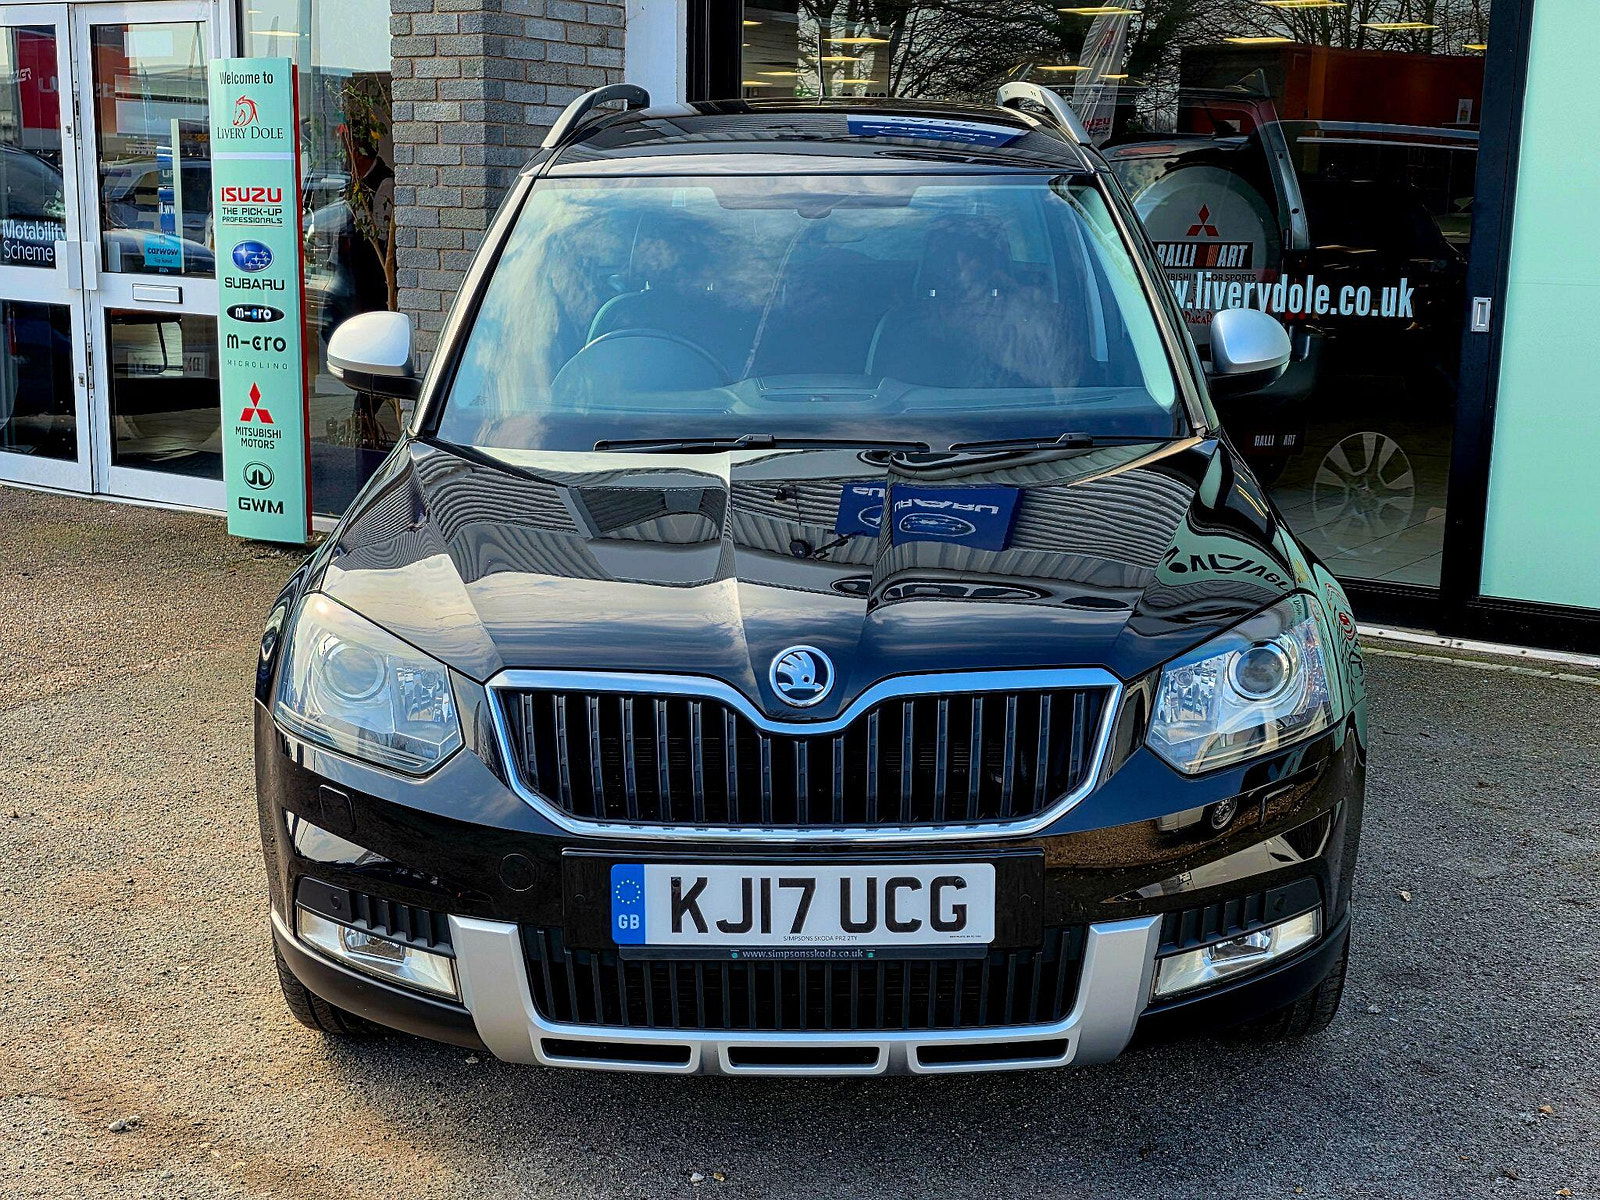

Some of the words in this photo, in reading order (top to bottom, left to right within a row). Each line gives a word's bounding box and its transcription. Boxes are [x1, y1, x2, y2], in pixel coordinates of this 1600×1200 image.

[219, 71, 260, 85] Welcome
[262, 71, 274, 84] to
[221, 187, 282, 203] ISUZU
[222, 207, 238, 215] THE
[241, 207, 283, 216] PICK-UP
[222, 216, 283, 224] PROFESSIONALS
[2, 219, 67, 241] Motability
[3, 240, 54, 262] Scheme
[224, 276, 285, 291] SUBARU
[1225, 273, 1257, 281] SPORTS
[227, 359, 288, 370] MICROLINO
[235, 426, 282, 439] MITSUBISHI
[241, 438, 275, 450] MOTORS
[238, 496, 284, 514] GWM
[670, 876, 817, 934] KJ17
[839, 875, 968, 934] UCG
[618, 914, 640, 930] GB
[742, 949, 864, 960] www.simpsonsskoda.co.uk
